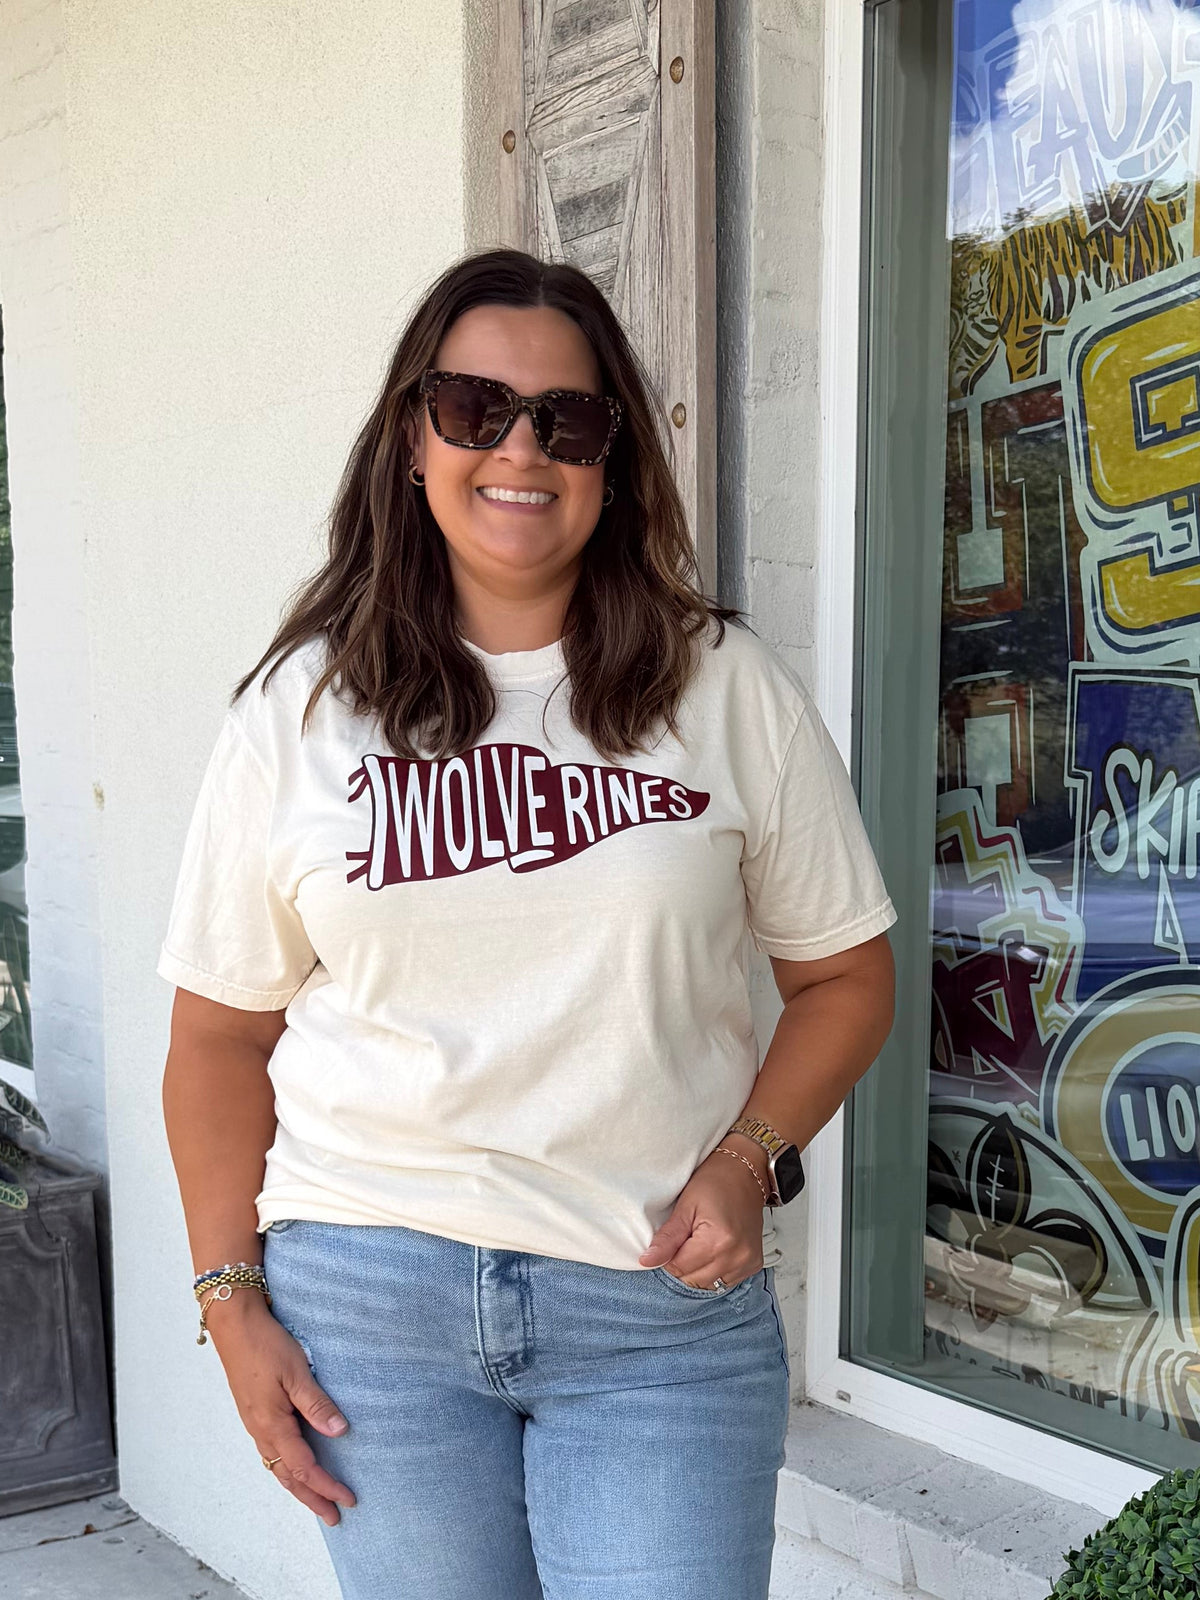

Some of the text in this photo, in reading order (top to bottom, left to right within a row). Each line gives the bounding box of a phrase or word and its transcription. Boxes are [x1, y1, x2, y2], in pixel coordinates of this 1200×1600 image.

[946, 0, 1192, 234] EAUX
[387, 746, 693, 879] WOLVERINES
[1119, 1084, 1200, 1161] LIO
